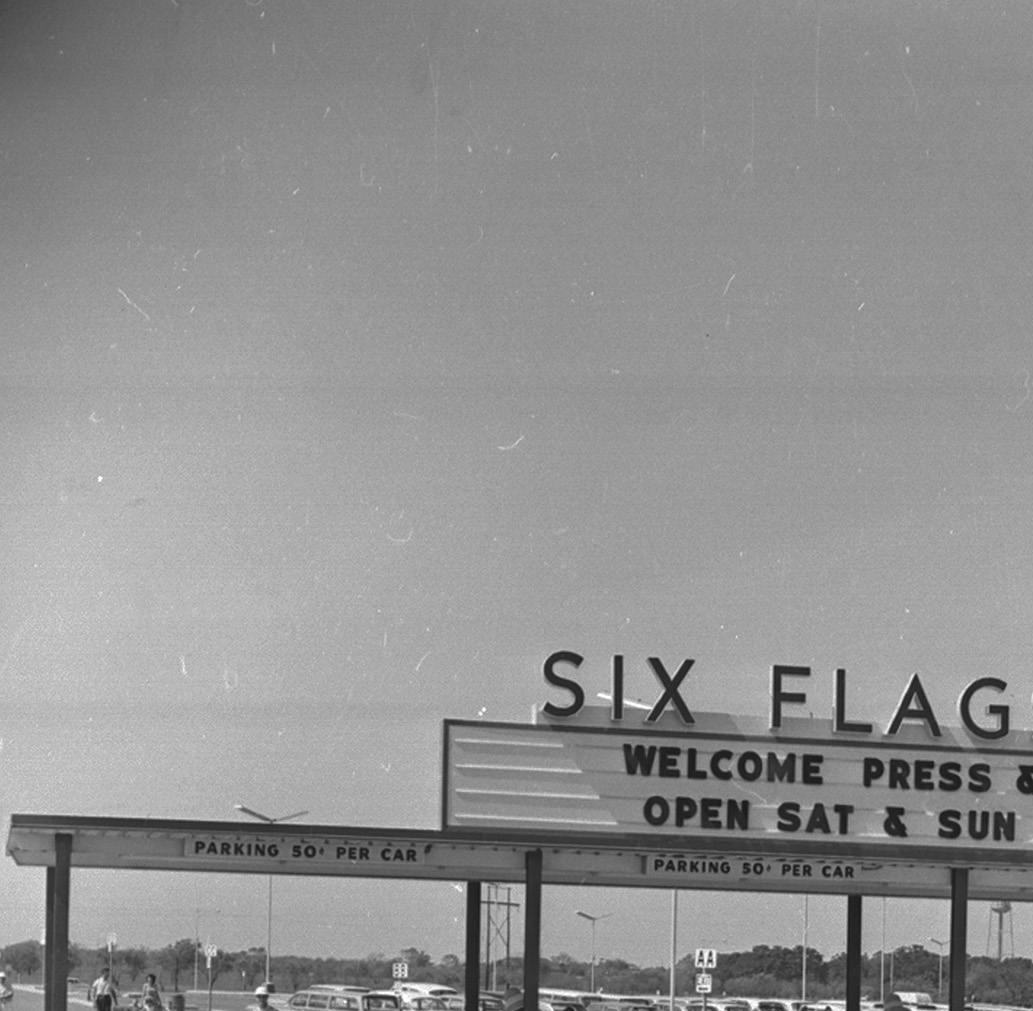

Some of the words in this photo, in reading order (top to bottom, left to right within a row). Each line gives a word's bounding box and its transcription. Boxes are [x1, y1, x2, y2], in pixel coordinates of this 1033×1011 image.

[540, 650, 695, 725] SIX
[623, 743, 824, 786] WELCOME
[863, 758, 992, 793] PRESS
[643, 797, 750, 830] OPEN
[777, 803, 855, 836] SAT
[883, 807, 909, 838] &
[938, 809, 1016, 842] SUN
[194, 840, 279, 857] PARKING
[336, 846, 370, 860] PER
[381, 848, 417, 862] CAR
[654, 859, 731, 874] PARKING
[782, 864, 812, 877] PER
[822, 865, 854, 878] CAR
[697, 950, 714, 967] AA
